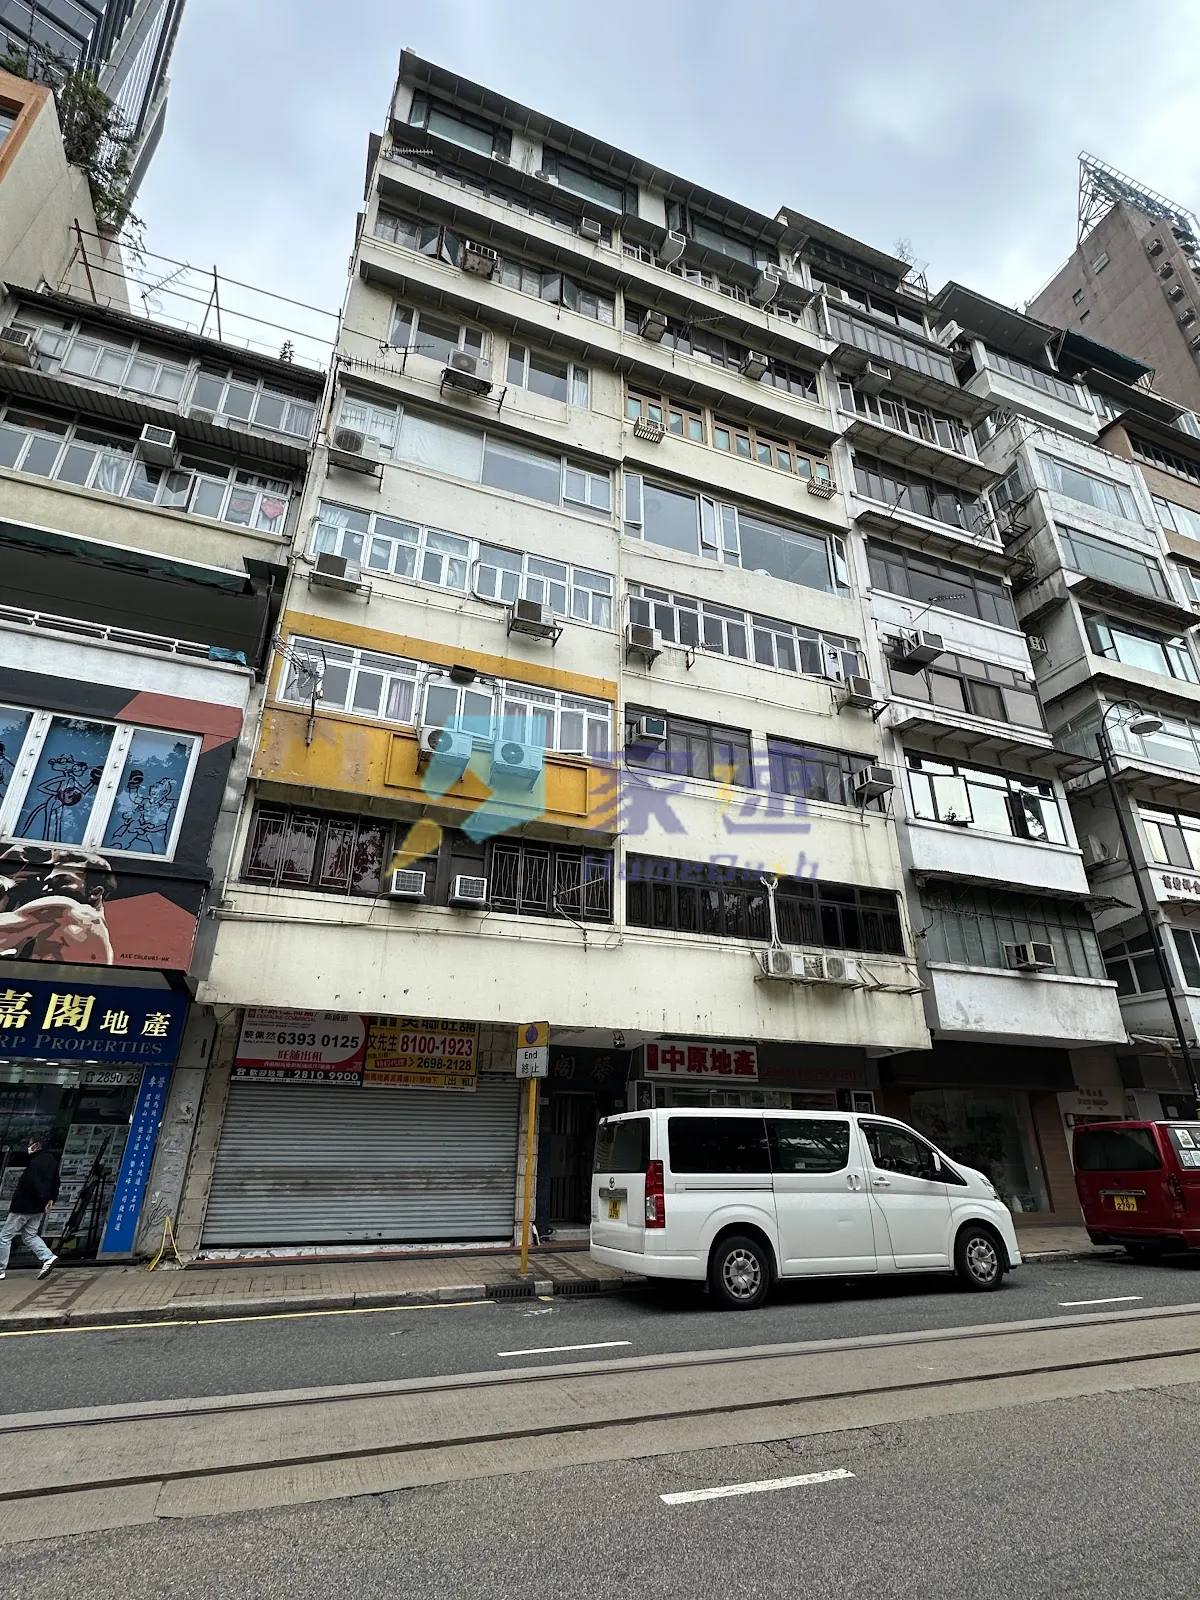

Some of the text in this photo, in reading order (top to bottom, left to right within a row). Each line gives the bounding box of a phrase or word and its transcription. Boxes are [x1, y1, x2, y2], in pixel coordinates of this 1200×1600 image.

[33, 1034, 163, 1055] PROPERTIES
[277, 1032, 316, 1046] 6393
[321, 1034, 360, 1048] 0125
[400, 1034, 473, 1057] 8100-1923
[524, 1051, 538, 1060] End
[661, 1045, 758, 1076] 中原地產
[416, 1057, 472, 1071] 2698-2128
[521, 1062, 540, 1074] 終止
[97, 1072, 140, 1084] 2890 28
[293, 1070, 324, 1079] 2810
[329, 1072, 359, 1081] 9900
